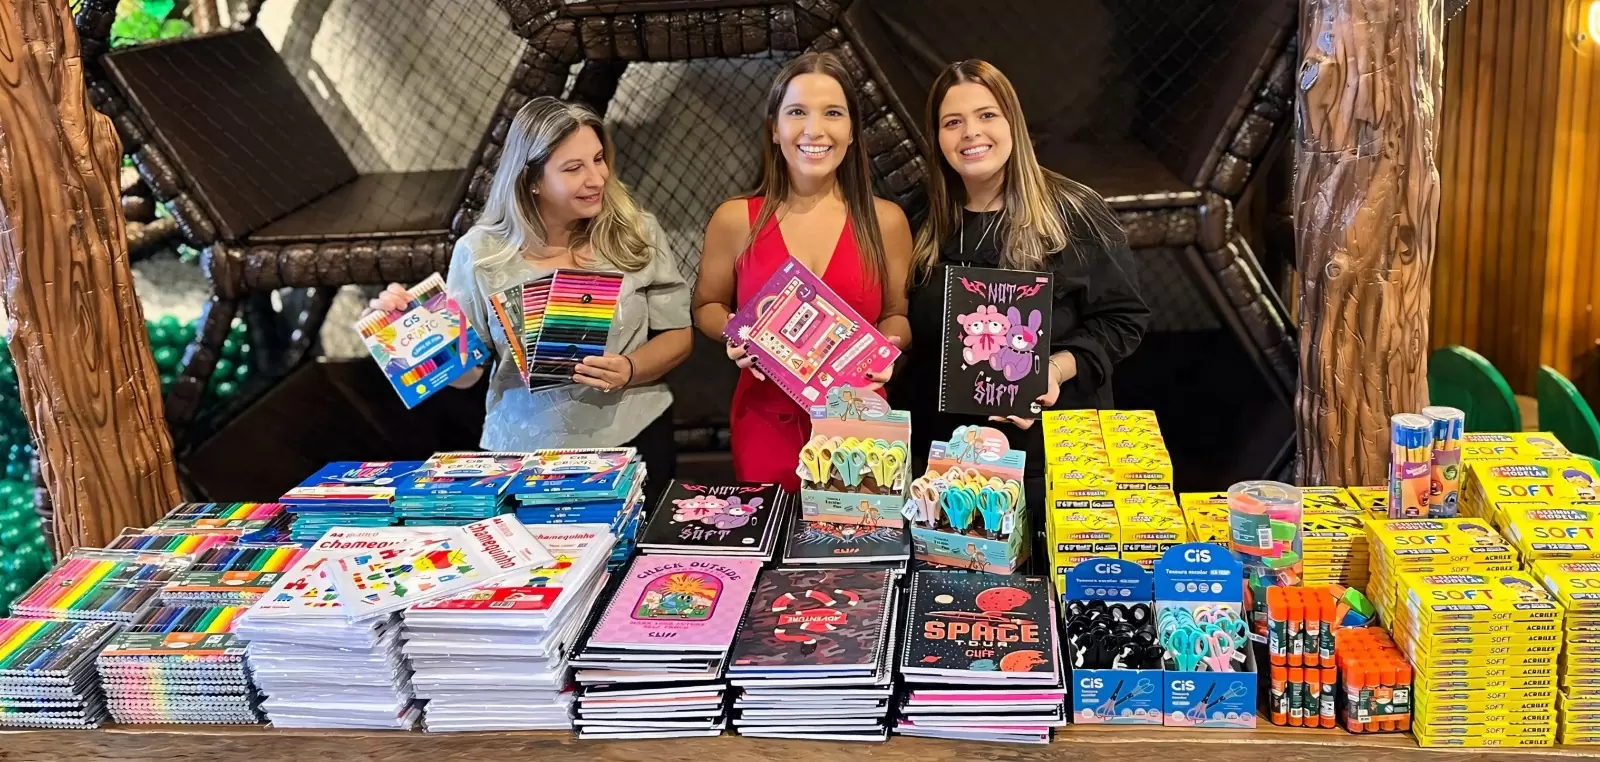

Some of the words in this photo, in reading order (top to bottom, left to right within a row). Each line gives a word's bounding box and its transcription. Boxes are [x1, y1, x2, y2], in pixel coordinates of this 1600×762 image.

[1465, 446, 1519, 455] SOFT
[1497, 485, 1555, 497] SOFT
[1533, 527, 1594, 538] SOFT
[1395, 535, 1451, 545] SOFT
[468, 522, 516, 570] chamequinho
[1184, 550, 1212, 563] CiS
[637, 562, 683, 580] CHECK
[690, 561, 741, 581] OUTSIDE
[1094, 564, 1122, 574] CiS
[1570, 579, 1600, 589] SO
[1432, 590, 1494, 600] SOFT
[923, 620, 1040, 644] SPACE
[955, 640, 1009, 648] TOUR
[965, 650, 995, 658] CLIFF
[1080, 678, 1104, 689] CiS
[1171, 680, 1196, 692] CiS
